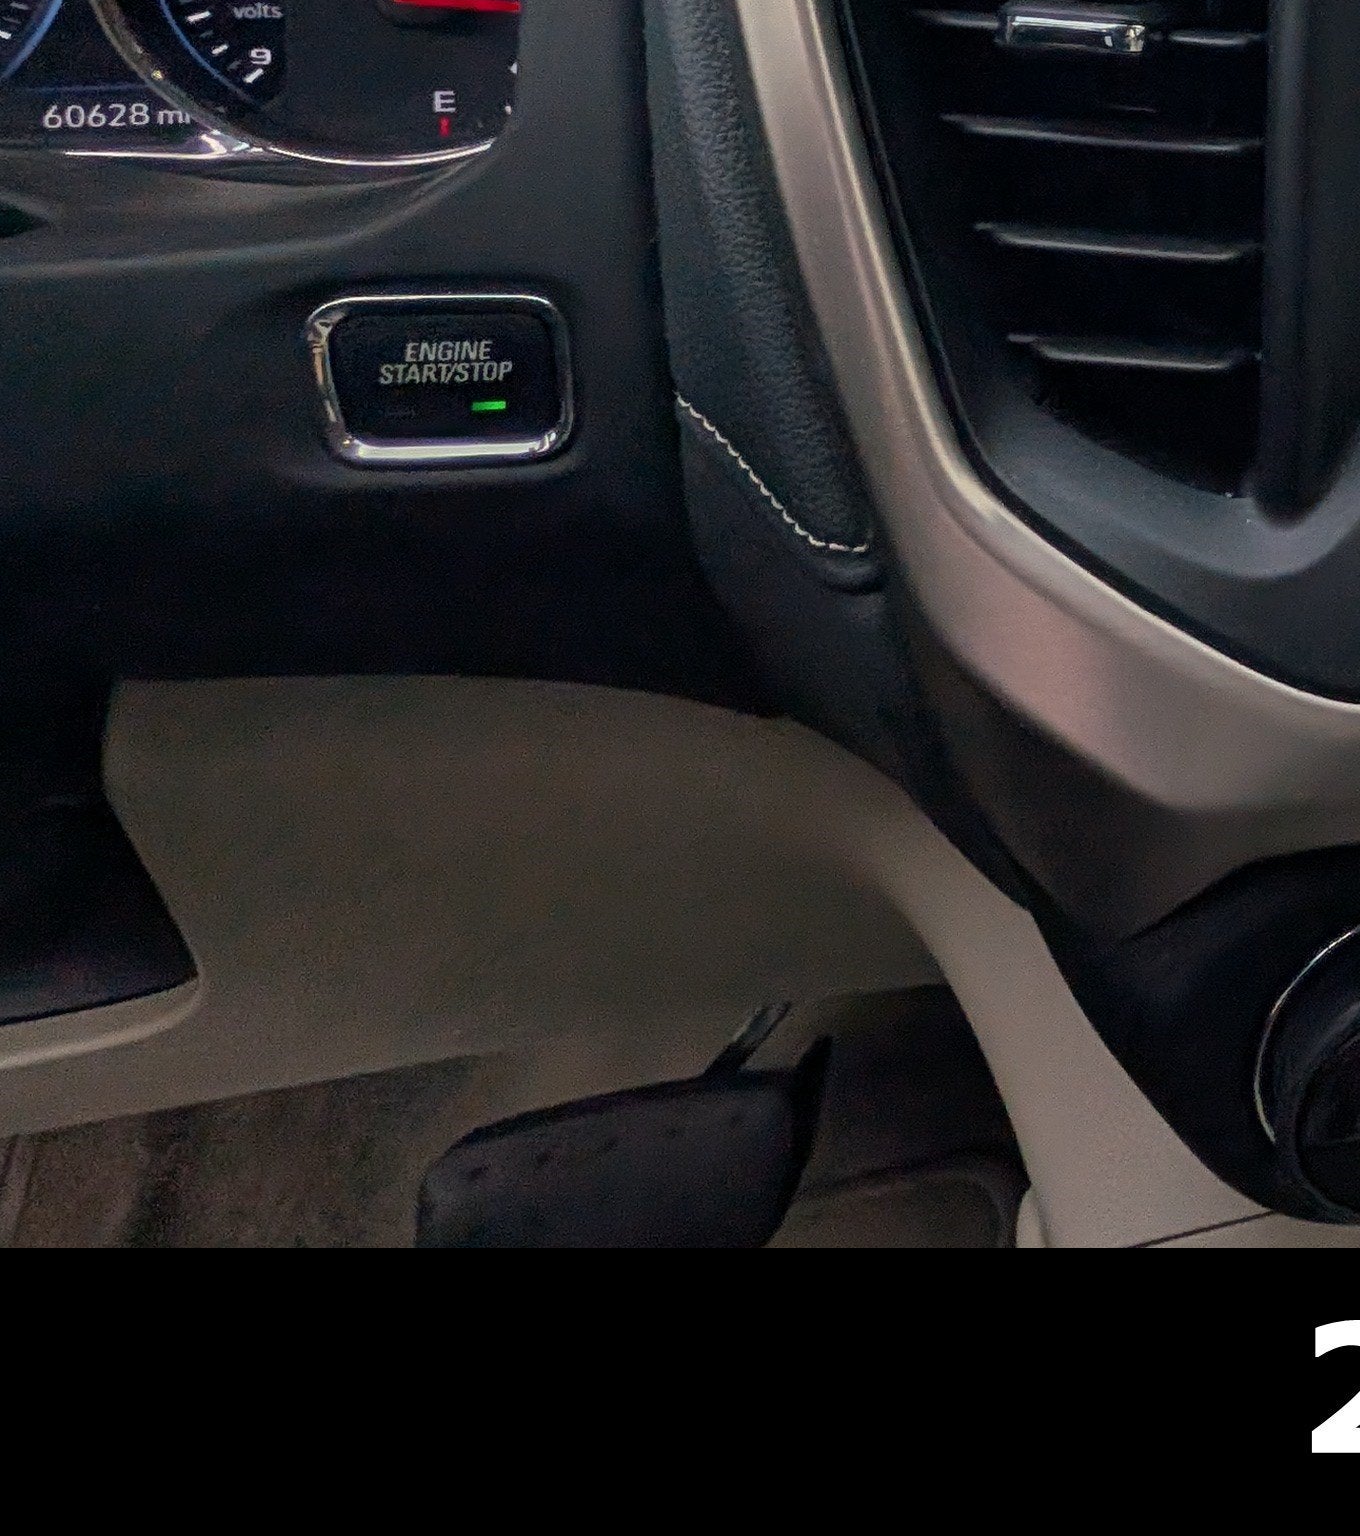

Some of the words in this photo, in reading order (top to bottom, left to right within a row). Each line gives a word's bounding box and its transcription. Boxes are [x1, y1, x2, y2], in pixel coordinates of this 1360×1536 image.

[233, 3, 284, 20] volts
[249, 47, 273, 66] 9
[433, 90, 457, 114] E
[42, 102, 151, 129] 60628
[157, 106, 193, 126] mi
[404, 340, 493, 363] ENGINE
[378, 361, 514, 386] START/STOP
